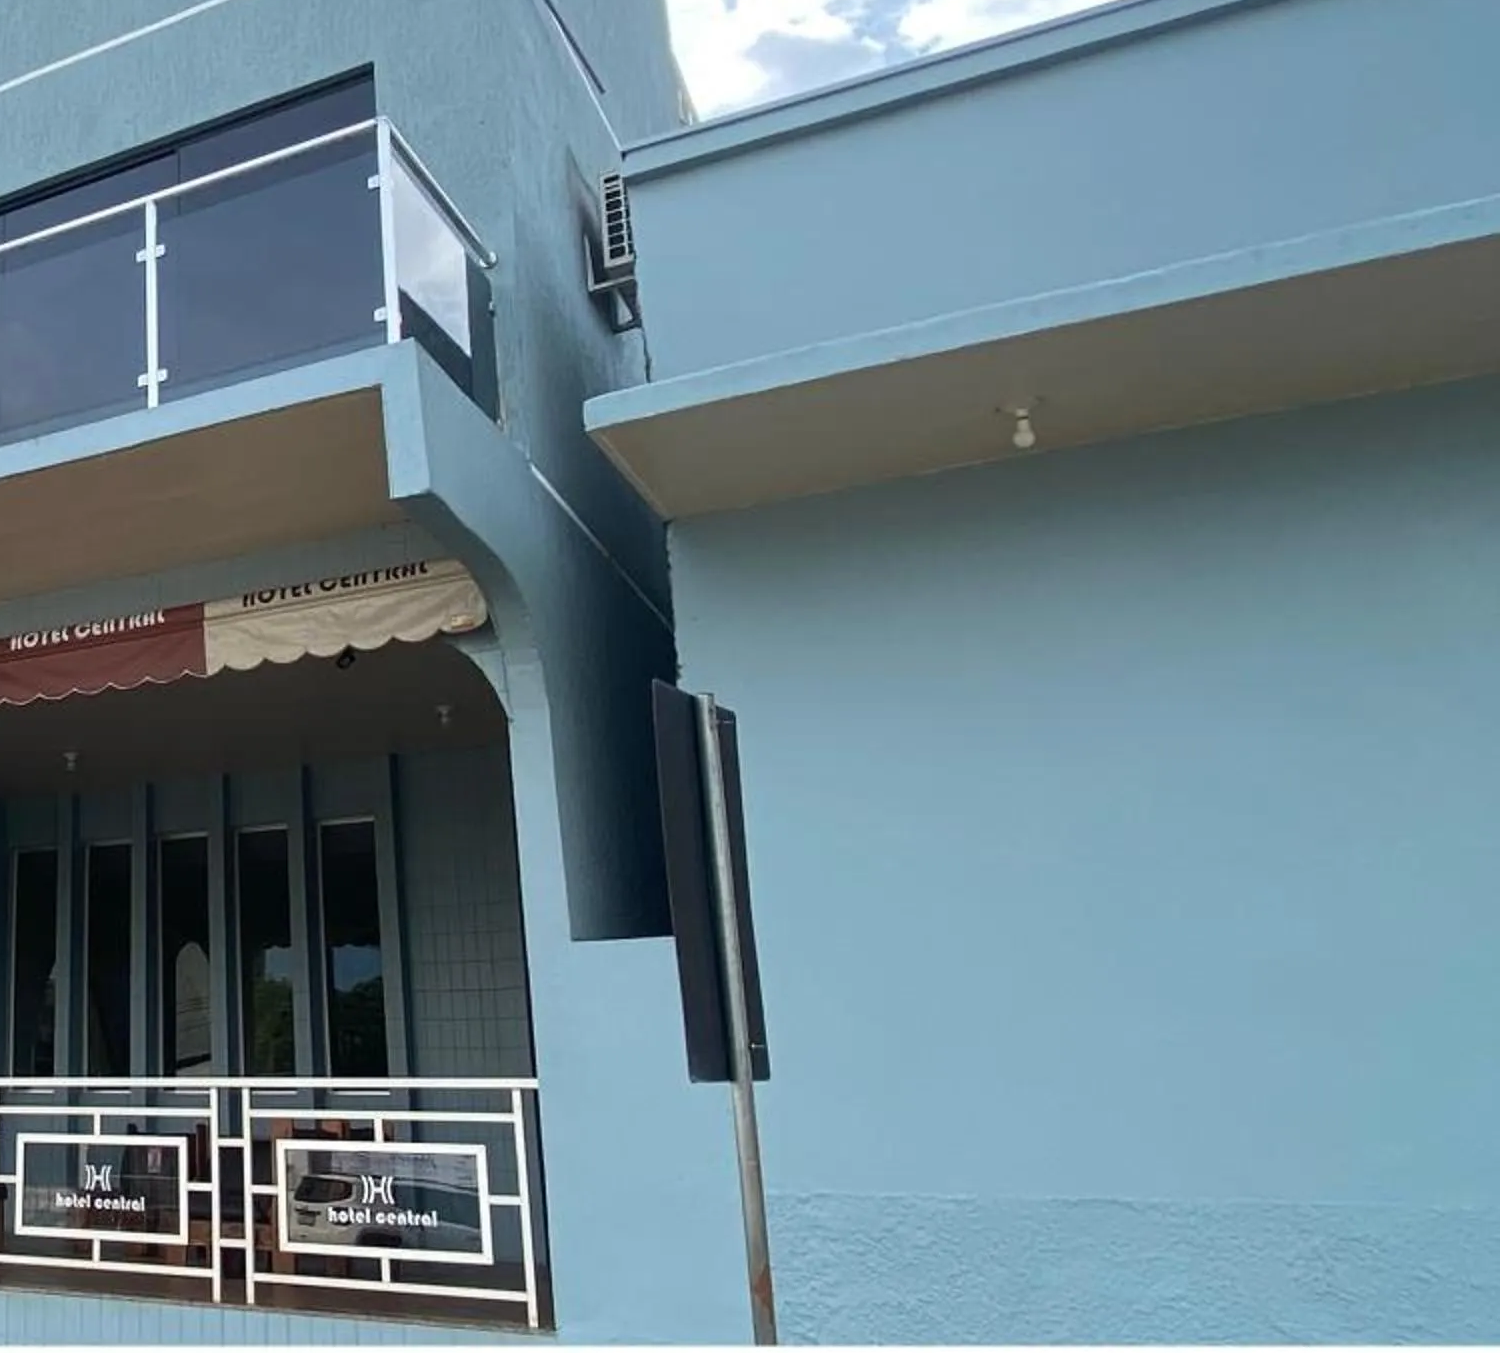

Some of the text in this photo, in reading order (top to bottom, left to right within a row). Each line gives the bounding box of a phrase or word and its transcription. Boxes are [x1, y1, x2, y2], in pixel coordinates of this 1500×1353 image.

[55, 1192, 145, 1211] hotel central
[328, 1207, 437, 1227] hotel central
